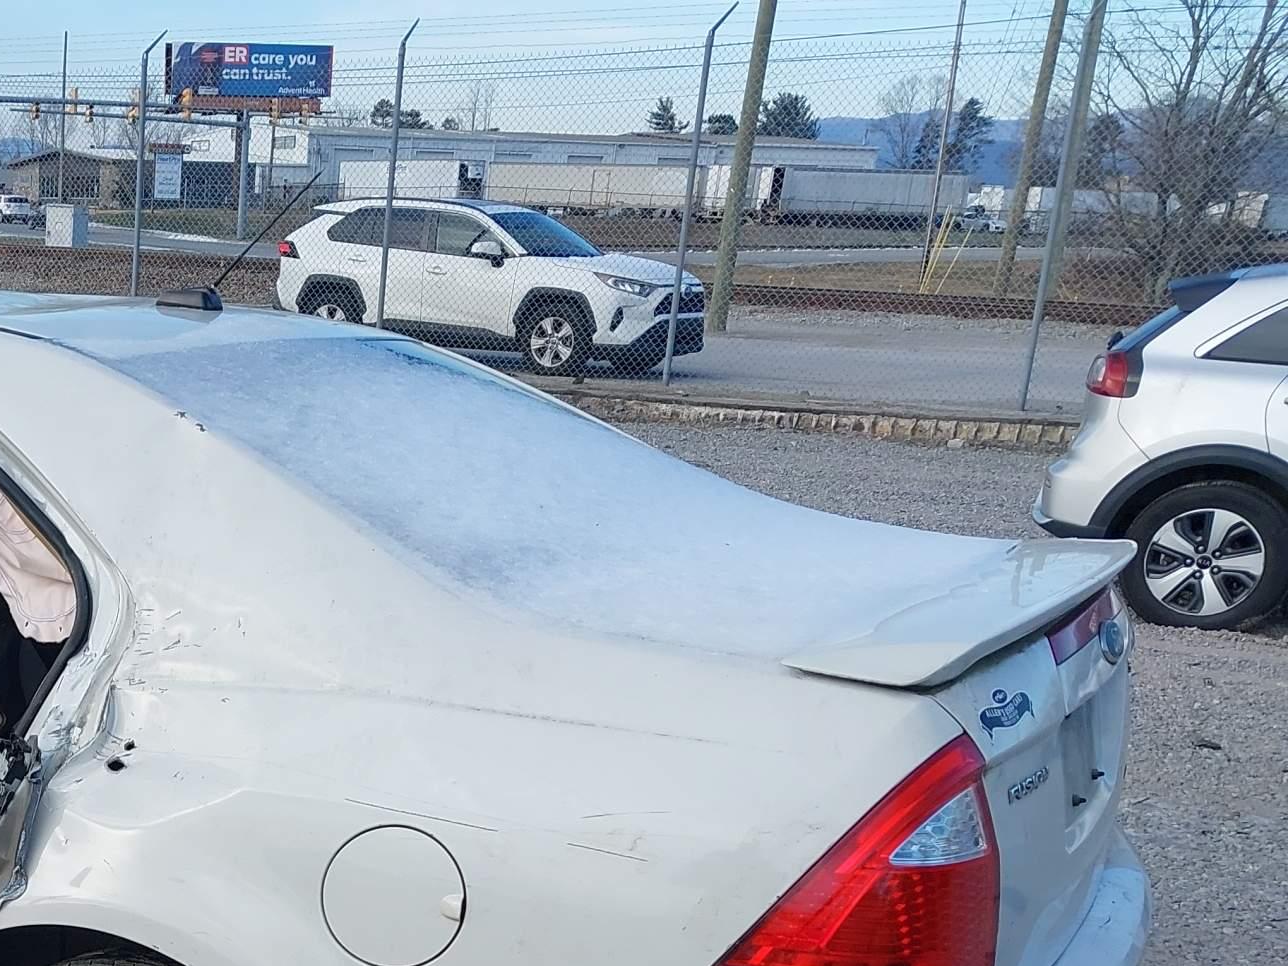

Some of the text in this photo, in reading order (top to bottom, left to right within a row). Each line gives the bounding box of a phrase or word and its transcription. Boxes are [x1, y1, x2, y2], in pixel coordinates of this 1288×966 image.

[224, 46, 248, 63] ER
[251, 53, 284, 65] care
[288, 53, 316, 68] you
[222, 67, 292, 80] can trust.
[1007, 765, 1049, 805] FUSION
